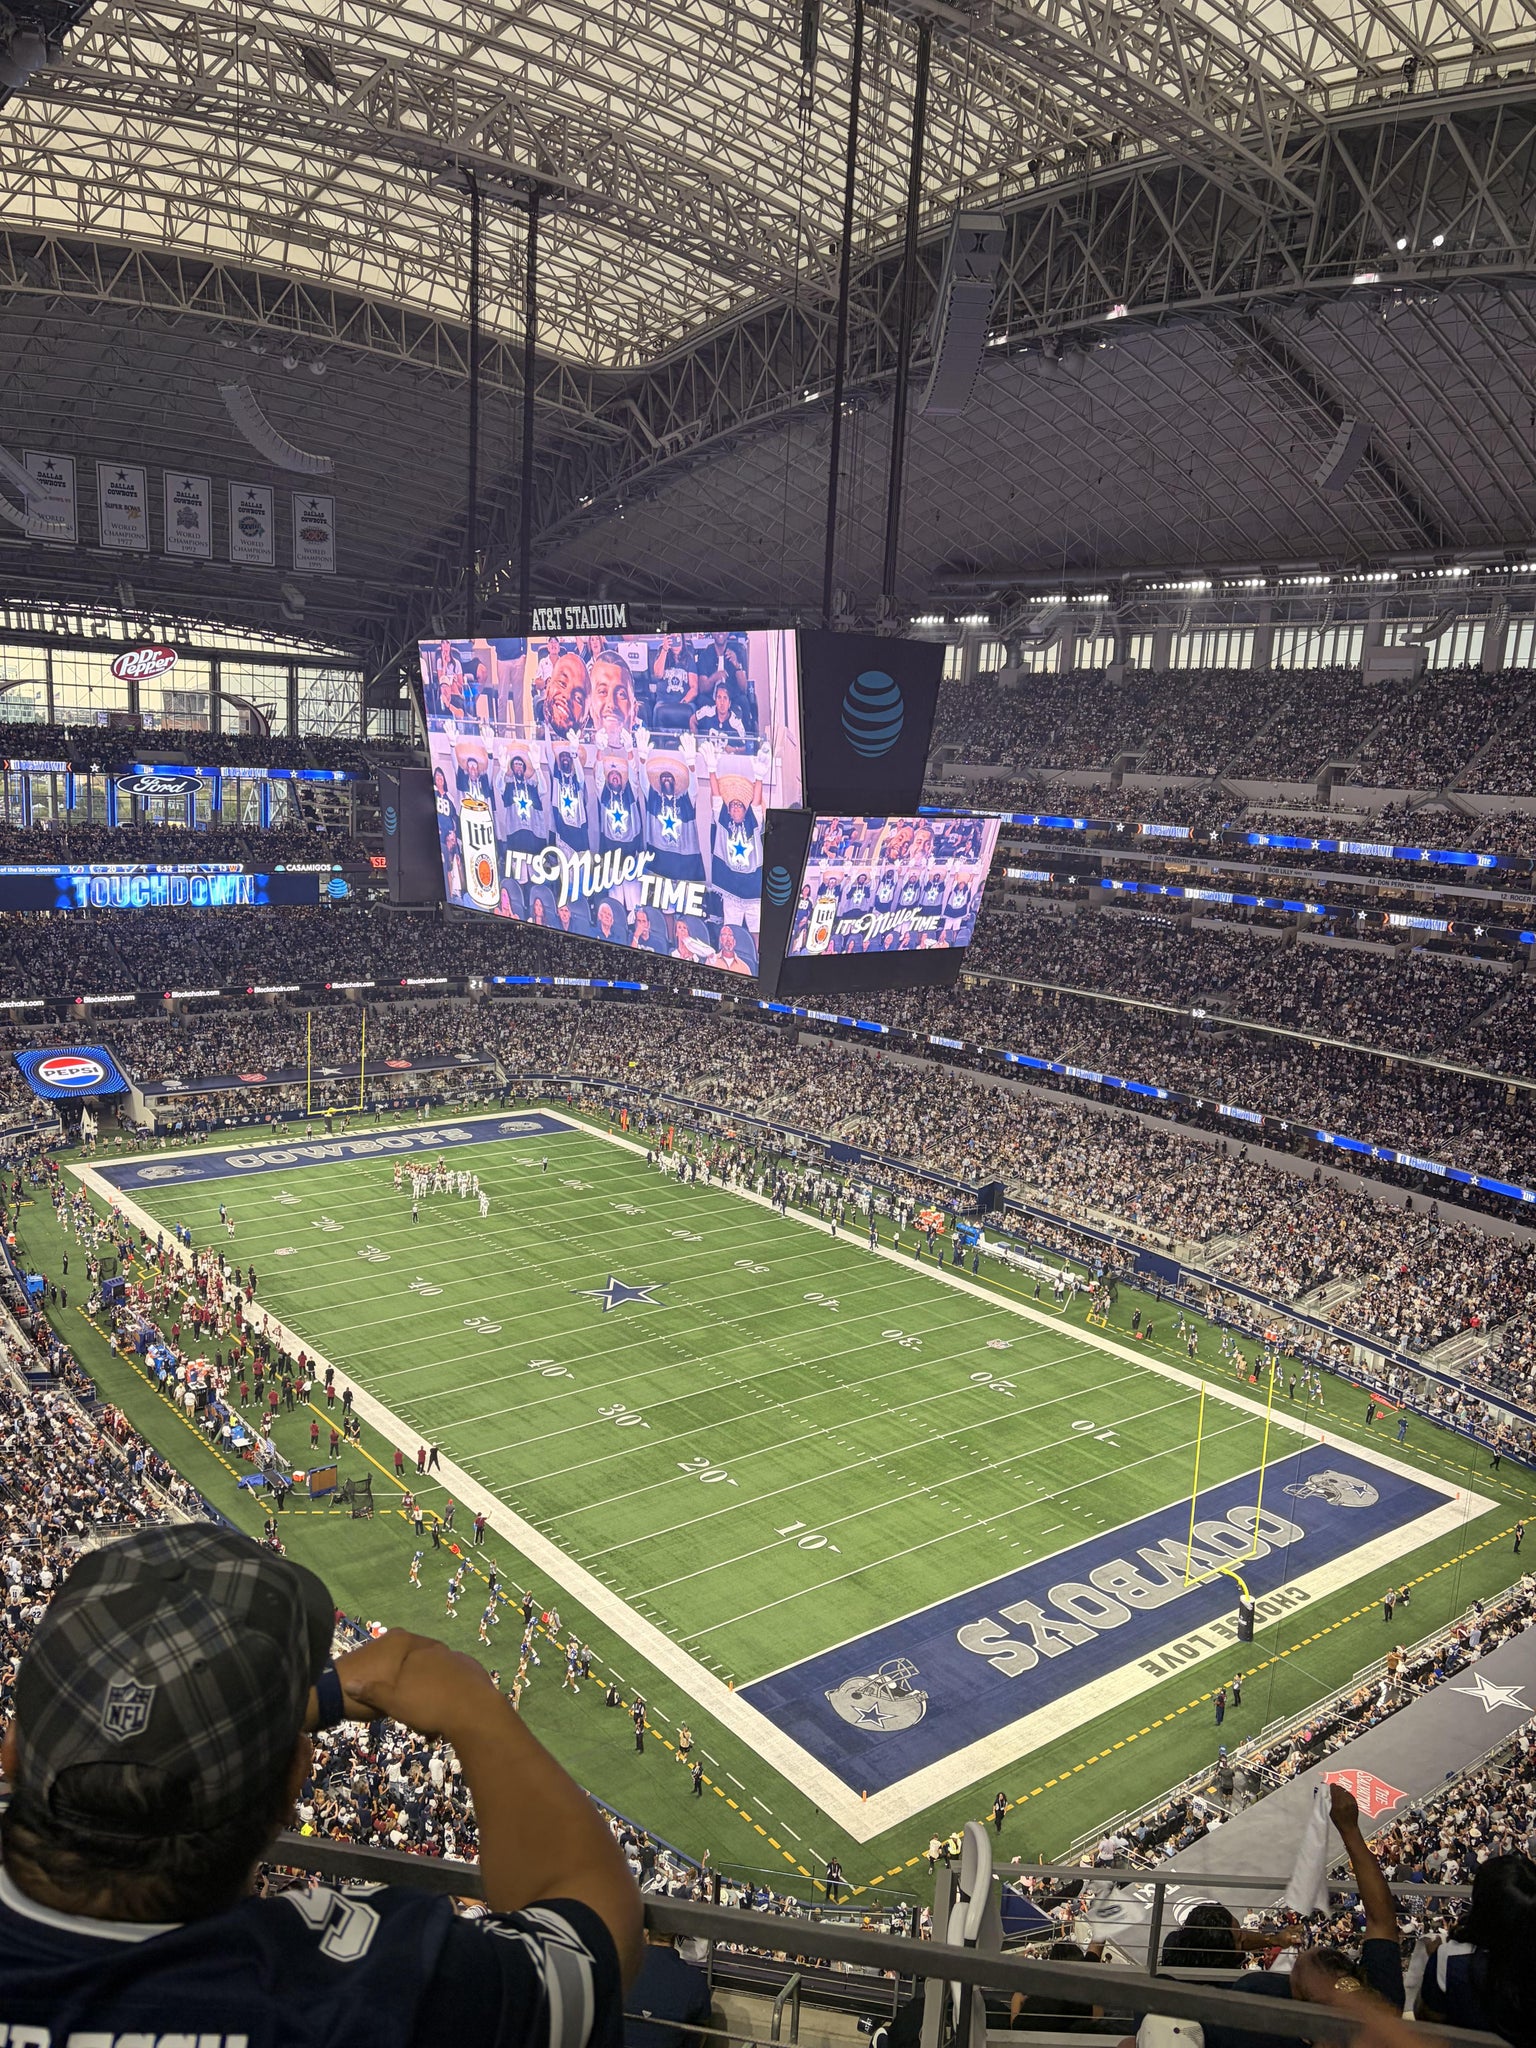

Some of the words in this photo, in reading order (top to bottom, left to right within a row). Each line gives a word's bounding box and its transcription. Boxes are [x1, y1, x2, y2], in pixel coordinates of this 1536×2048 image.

[37, 471, 63, 480] DALLAS
[36, 478, 66, 488] WBOYS
[110, 482, 134, 491] DALLAS
[108, 488, 138, 498] COWBOYS
[176, 491, 199, 500] DALLAS
[104, 502, 123, 511] SUPER
[173, 497, 202, 506] COWBOYS
[241, 501, 263, 509] DALLAS
[238, 507, 265, 515] COWBOYS
[303, 510, 325, 518] DALLAS
[38, 514, 65, 522] WORLD
[301, 516, 327, 524] COWBOYS
[111, 522, 137, 531] WORLD
[104, 528, 145, 539] CHAMPIONS
[176, 530, 200, 539] WORLD
[169, 536, 208, 547] CHAMPIONS
[241, 539, 264, 547] WORLD
[234, 546, 271, 555] CHAMPIONS
[532, 607, 563, 631] AT&T
[564, 603, 628, 630] STADIUM
[138, 648, 163, 663] Dr
[119, 651, 175, 678] Pepper
[132, 776, 188, 794] Ford
[466, 820, 493, 851] Lite
[36, 866, 61, 874] Cowboys
[286, 864, 332, 872] CASAMIGOS
[505, 850, 546, 885] IT'S
[541, 845, 656, 908] Miller
[1378, 879, 1390, 887] DON
[1390, 881, 1415, 890] PERKINS
[71, 875, 255, 908] TOUCHDOWN
[816, 908, 835, 925] Lite
[835, 919, 863, 935] IT'S
[859, 906, 923, 941] Miller
[331, 981, 375, 990] Blockchain.com
[407, 977, 448, 985] Blockchain.com
[171, 989, 220, 999] Blockchain.com
[254, 985, 300, 994] Blockchain.com
[83, 995, 136, 1004] Blockchain.com
[43, 1066, 99, 1079] PEPSI
[225, 1128, 473, 1169] COWBOYS
[614, 1203, 647, 1216] 30
[310, 1218, 345, 1232] 20
[671, 1229, 704, 1242] 40
[357, 1247, 392, 1263] 30
[733, 1259, 770, 1274] 50
[408, 1282, 444, 1297] 40
[803, 1292, 842, 1310] 40
[463, 1316, 503, 1334] 50
[881, 1329, 923, 1348] 30
[527, 1358, 568, 1378] 40
[969, 1371, 1018, 1393] 20
[597, 1403, 643, 1427] 30
[1070, 1419, 1121, 1443] 10
[676, 1456, 728, 1484] 20
[773, 1520, 829, 1550] 10
[956, 1505, 1305, 1678] COWBOYS
[1137, 1634, 1217, 1678] LOVE
[109, 1704, 145, 1730] NFL
[1356, 1771, 1373, 1814] SALVATION
[1375, 1786, 1390, 1806] THE
